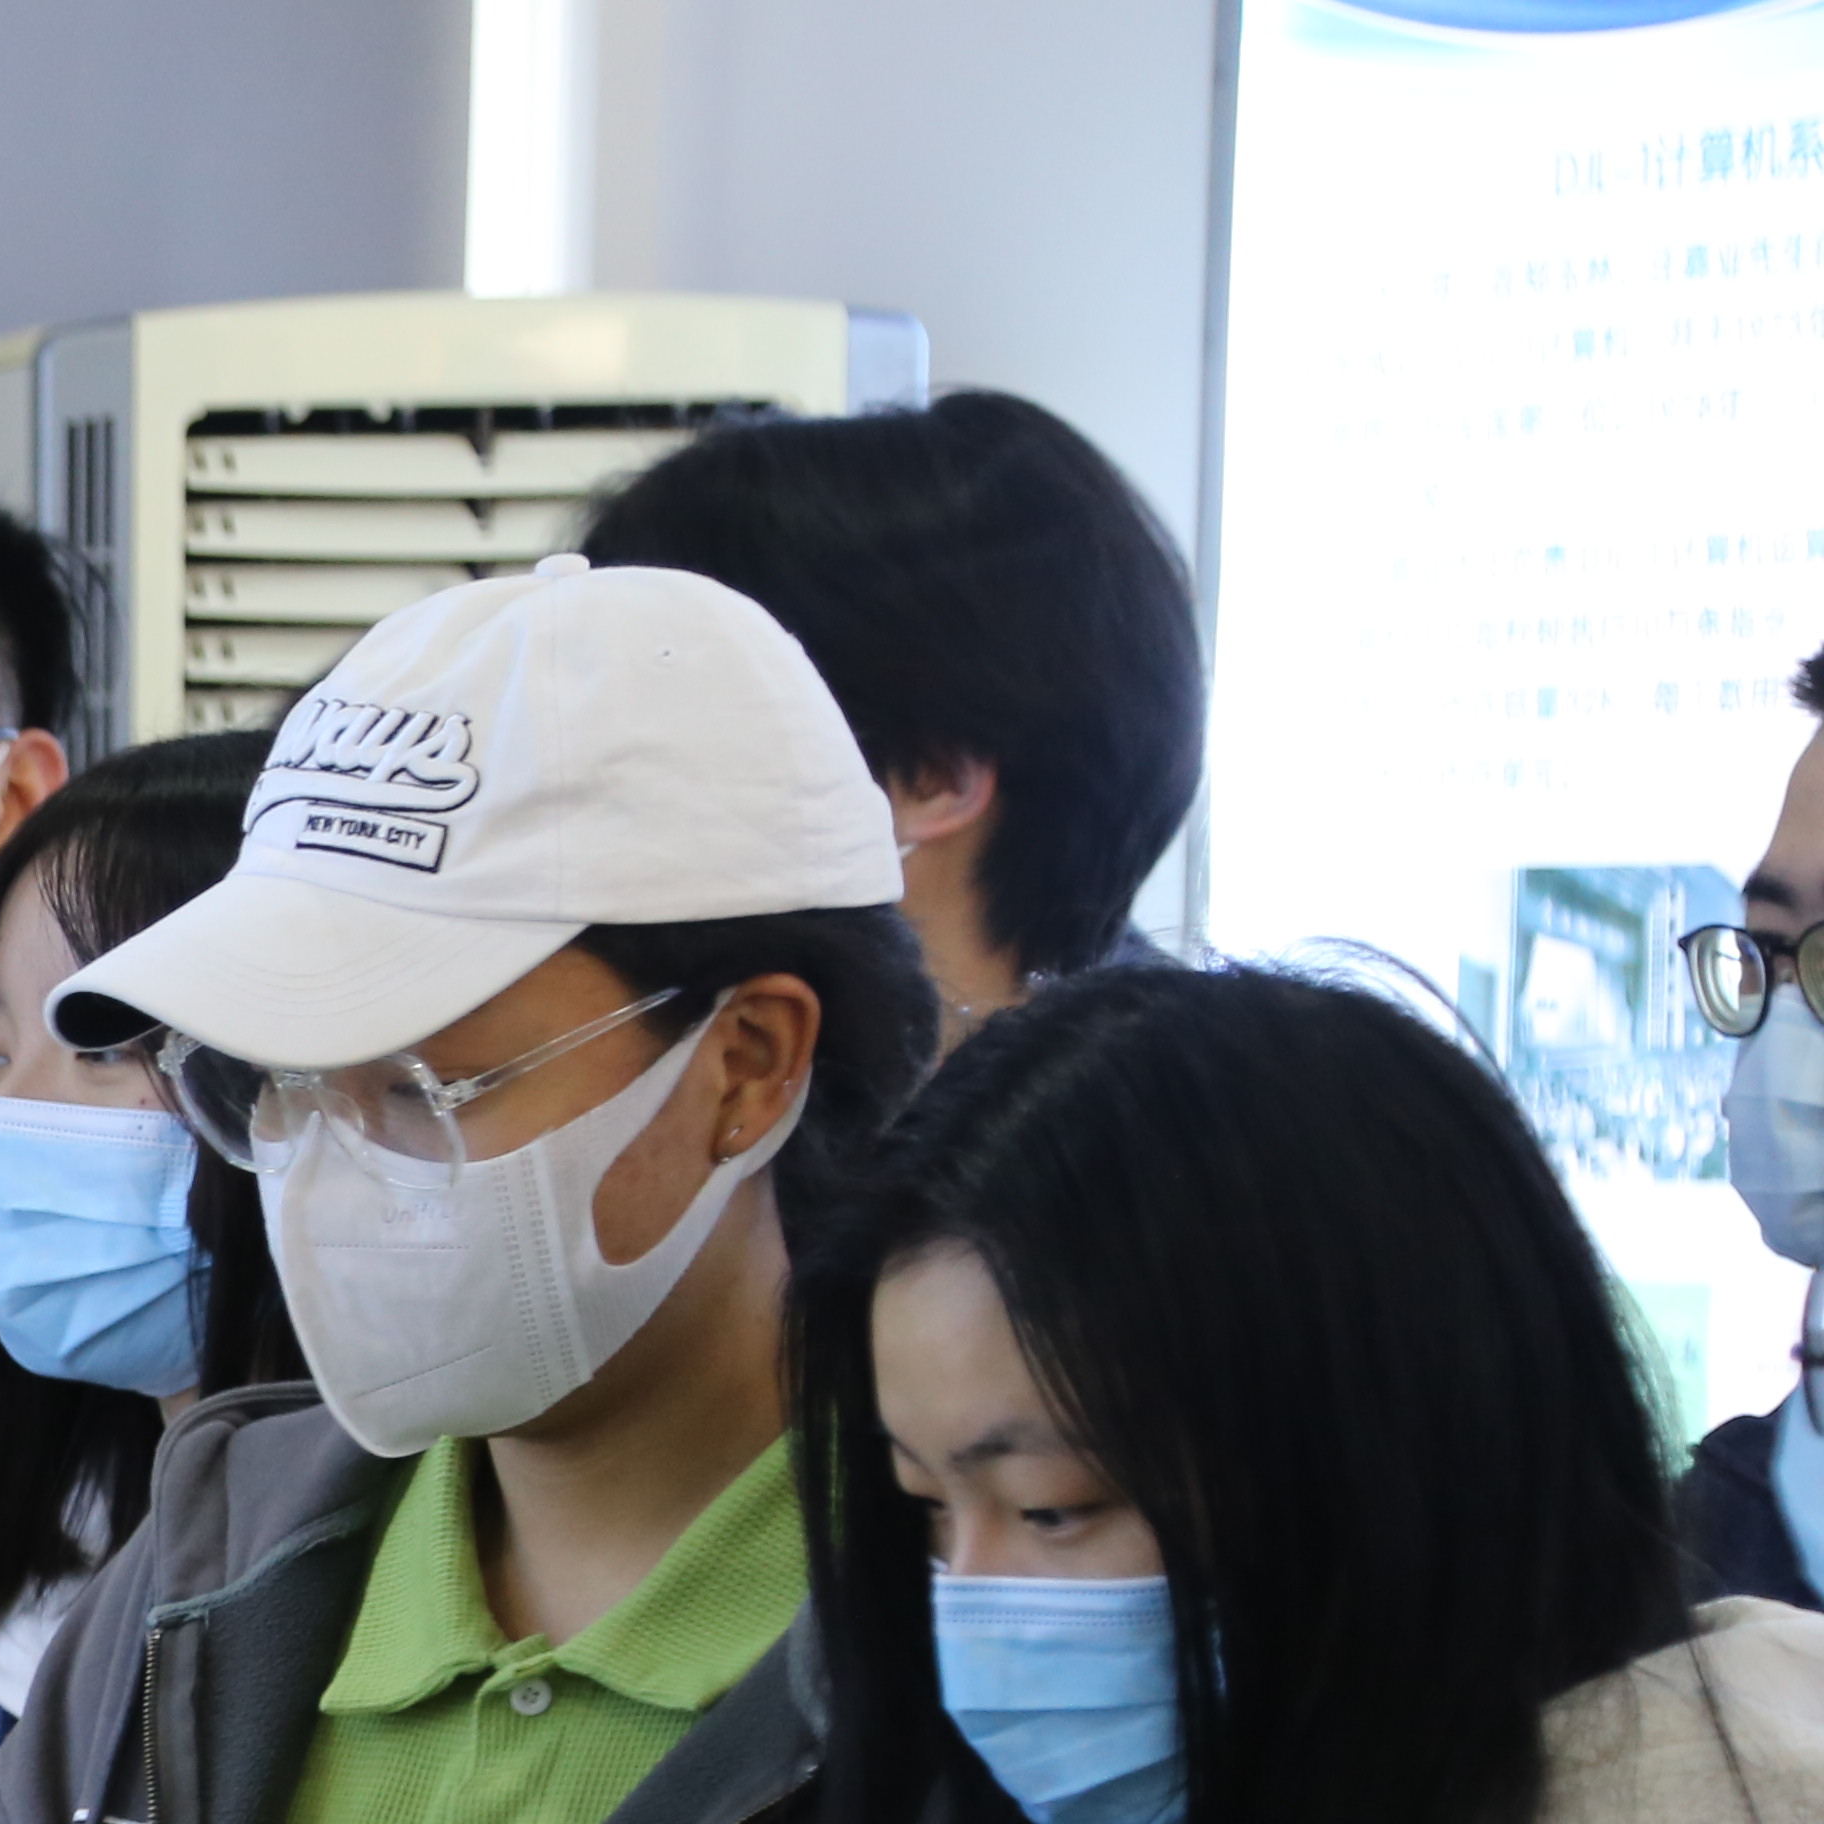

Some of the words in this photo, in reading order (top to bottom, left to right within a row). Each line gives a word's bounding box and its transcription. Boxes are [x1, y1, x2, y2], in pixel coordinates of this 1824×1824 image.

[304, 814, 335, 833] NEW
[338, 817, 380, 840] YORK
[386, 827, 428, 849] CITY
